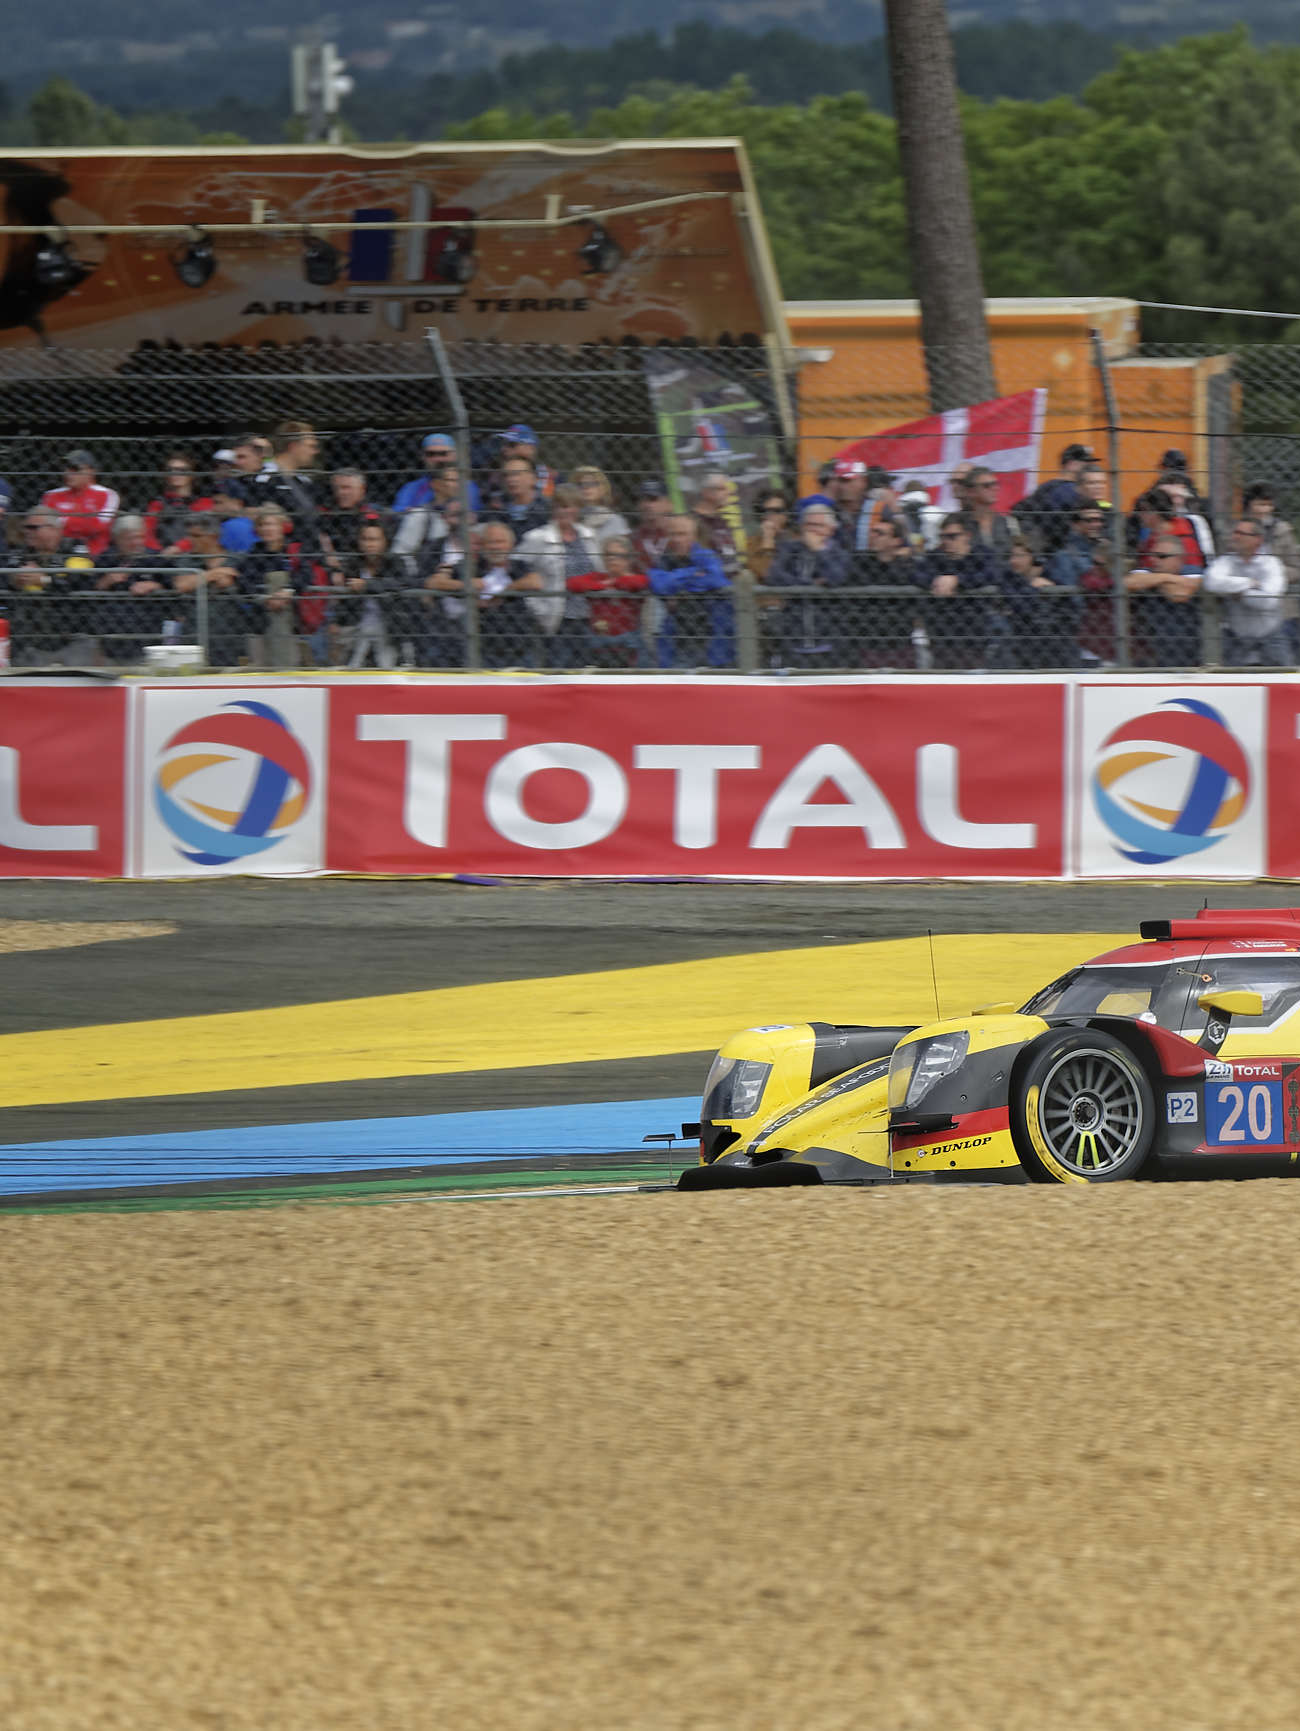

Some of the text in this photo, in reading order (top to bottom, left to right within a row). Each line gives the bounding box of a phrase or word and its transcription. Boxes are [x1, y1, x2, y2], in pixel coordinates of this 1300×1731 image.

[240, 298, 590, 315] ARMEE DE TERRE
[356, 713, 1036, 850] TOTAL
[1234, 1064, 1280, 1076] TOTAL
[1170, 1098, 1194, 1118] P2
[1218, 1085, 1272, 1141] 20
[930, 1136, 992, 1156] DUNLOP
